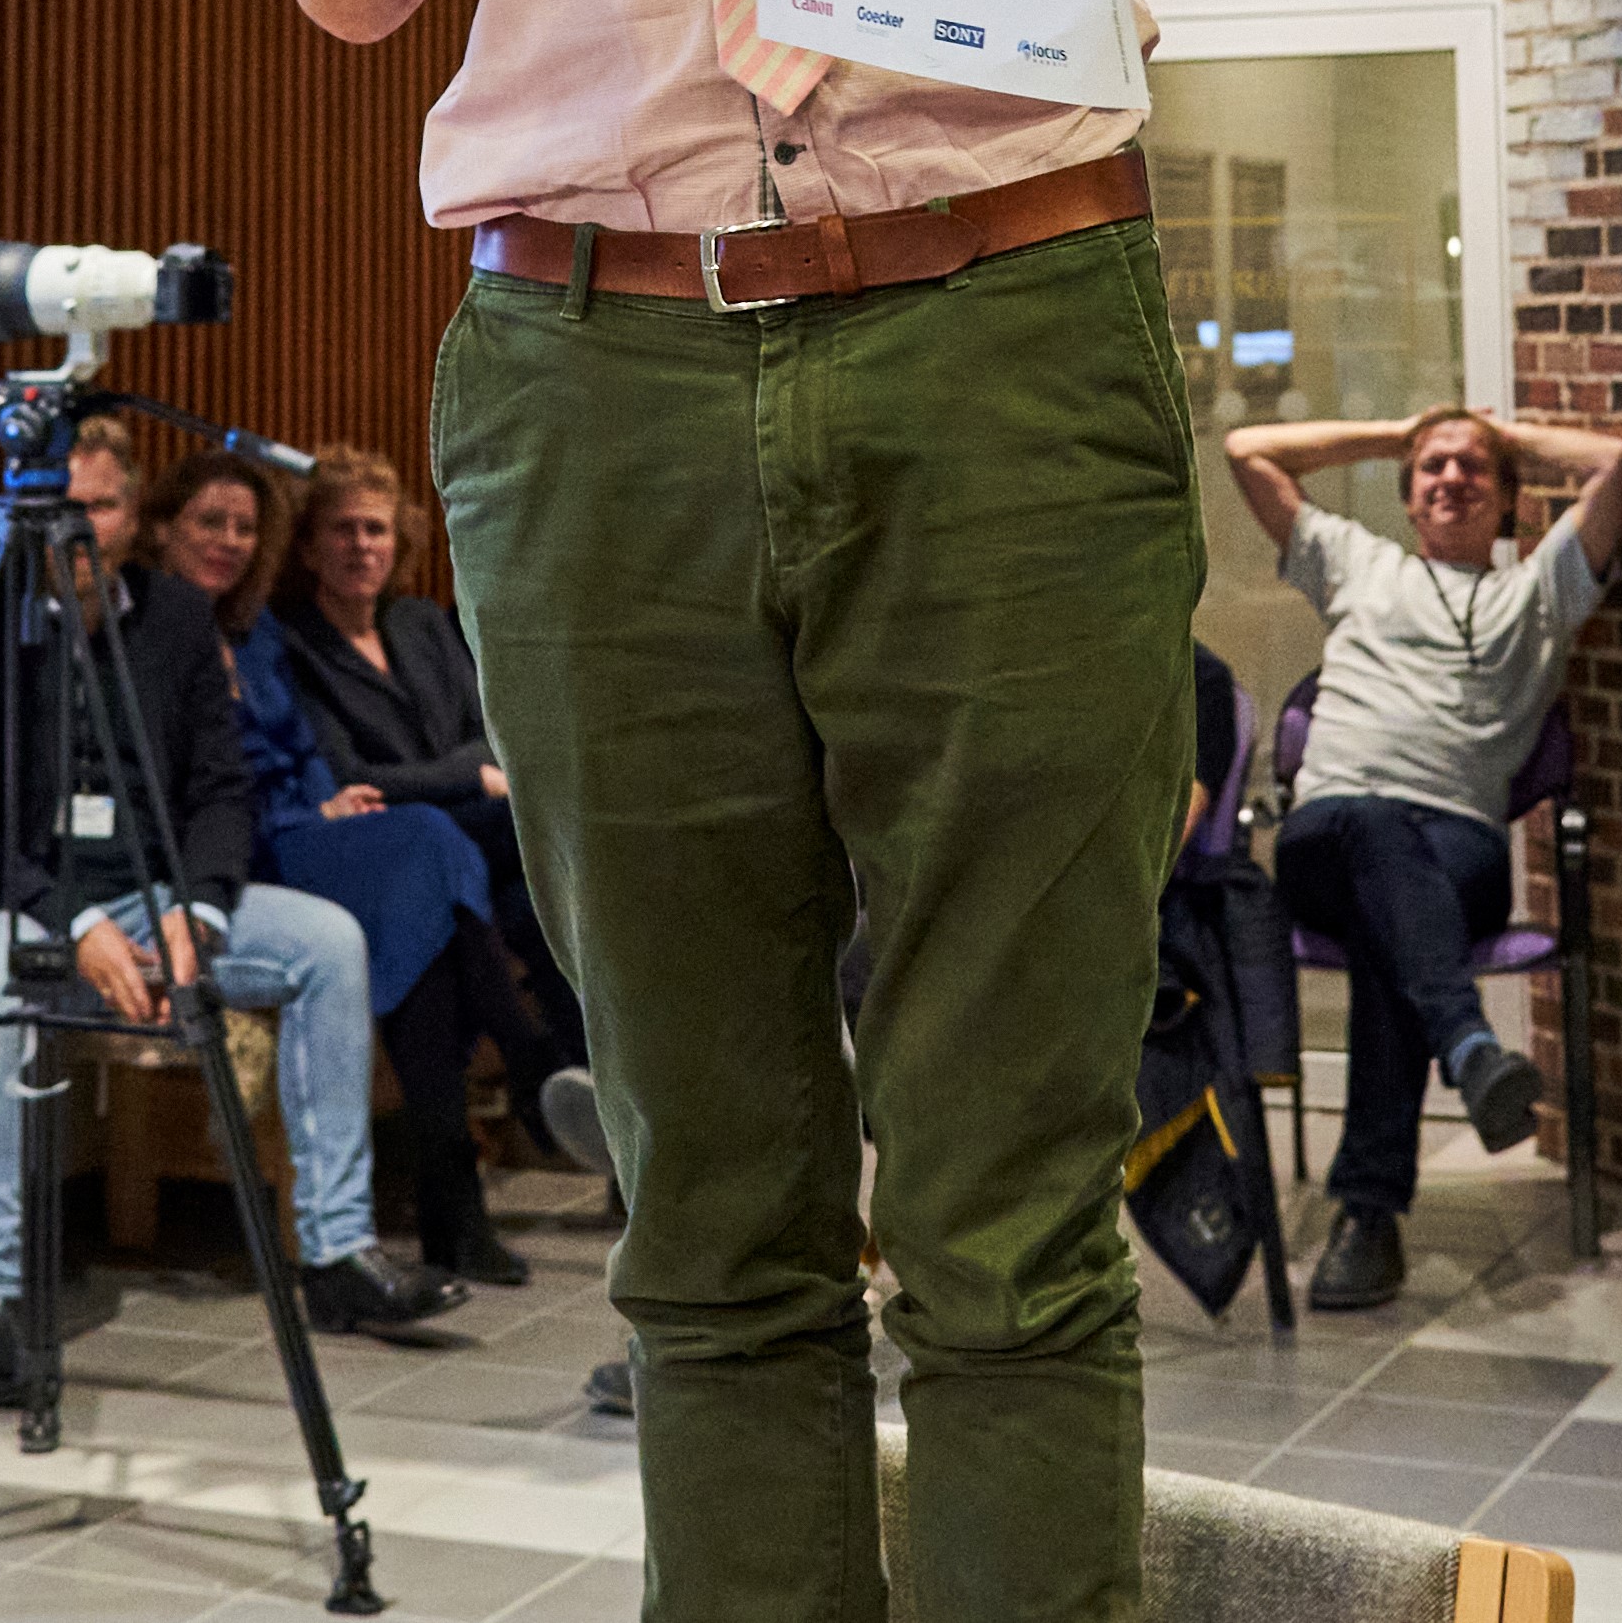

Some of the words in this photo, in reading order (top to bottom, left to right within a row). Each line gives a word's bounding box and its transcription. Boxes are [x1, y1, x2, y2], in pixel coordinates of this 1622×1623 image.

[857, 6, 905, 29] Goecker
[935, 24, 984, 46] SONY
[1031, 42, 1068, 62] focus
